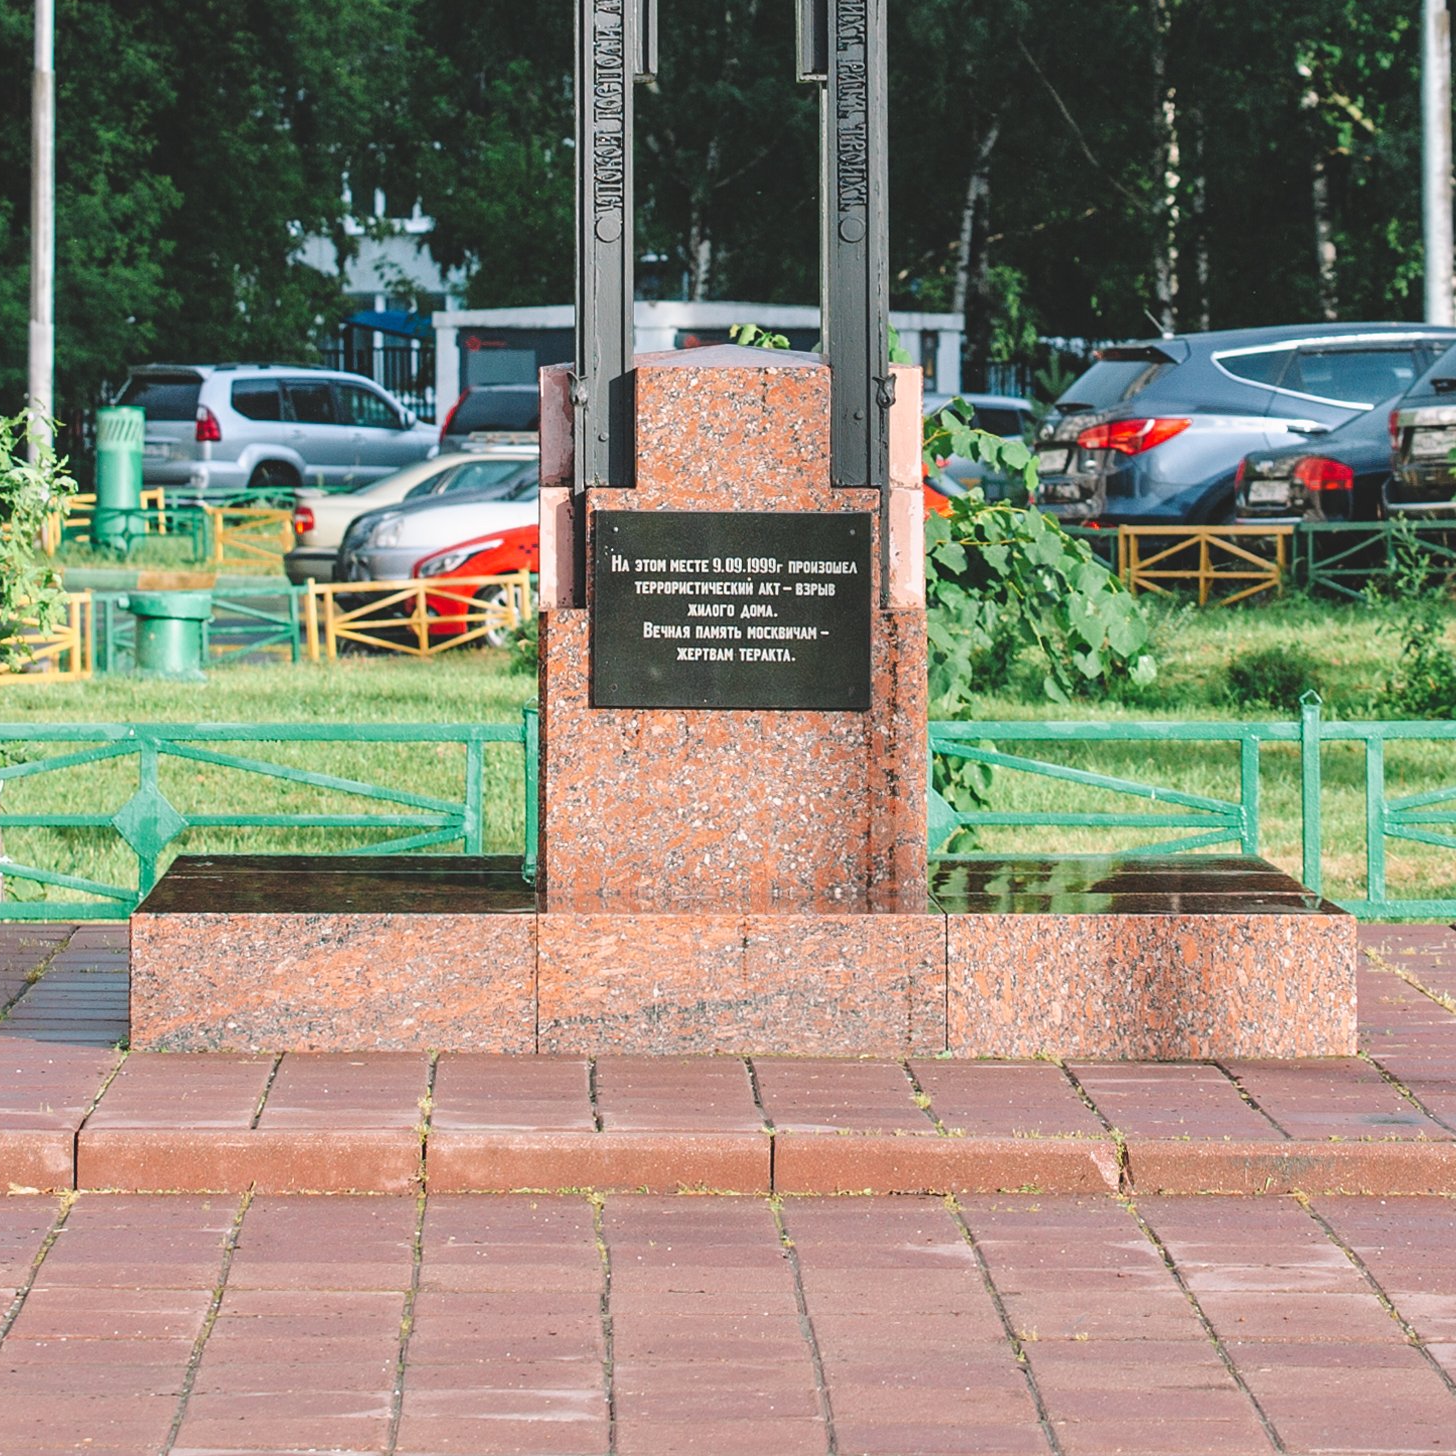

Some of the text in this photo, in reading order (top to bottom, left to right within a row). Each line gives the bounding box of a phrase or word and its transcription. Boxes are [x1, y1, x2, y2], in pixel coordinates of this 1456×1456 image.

[634, 558, 667, 573] ЭТОМ
[669, 559, 710, 573] МЕСТЕ
[788, 560, 858, 575] ПРОИЗОШЕЛ
[634, 577, 754, 596] ТЕРРОРИСТИЧЕСКИЙ
[758, 582, 781, 596] АКТ
[795, 582, 836, 597] ВЗРЫВ
[687, 603, 779, 619] ЖИЛОГО ДОМА.
[695, 625, 742, 640] ПАМЯТЬ
[747, 626, 817, 641] МОСКВИЧАМ
[676, 646, 796, 662] ЖЕРТВАМ ТЕРАКТА.
